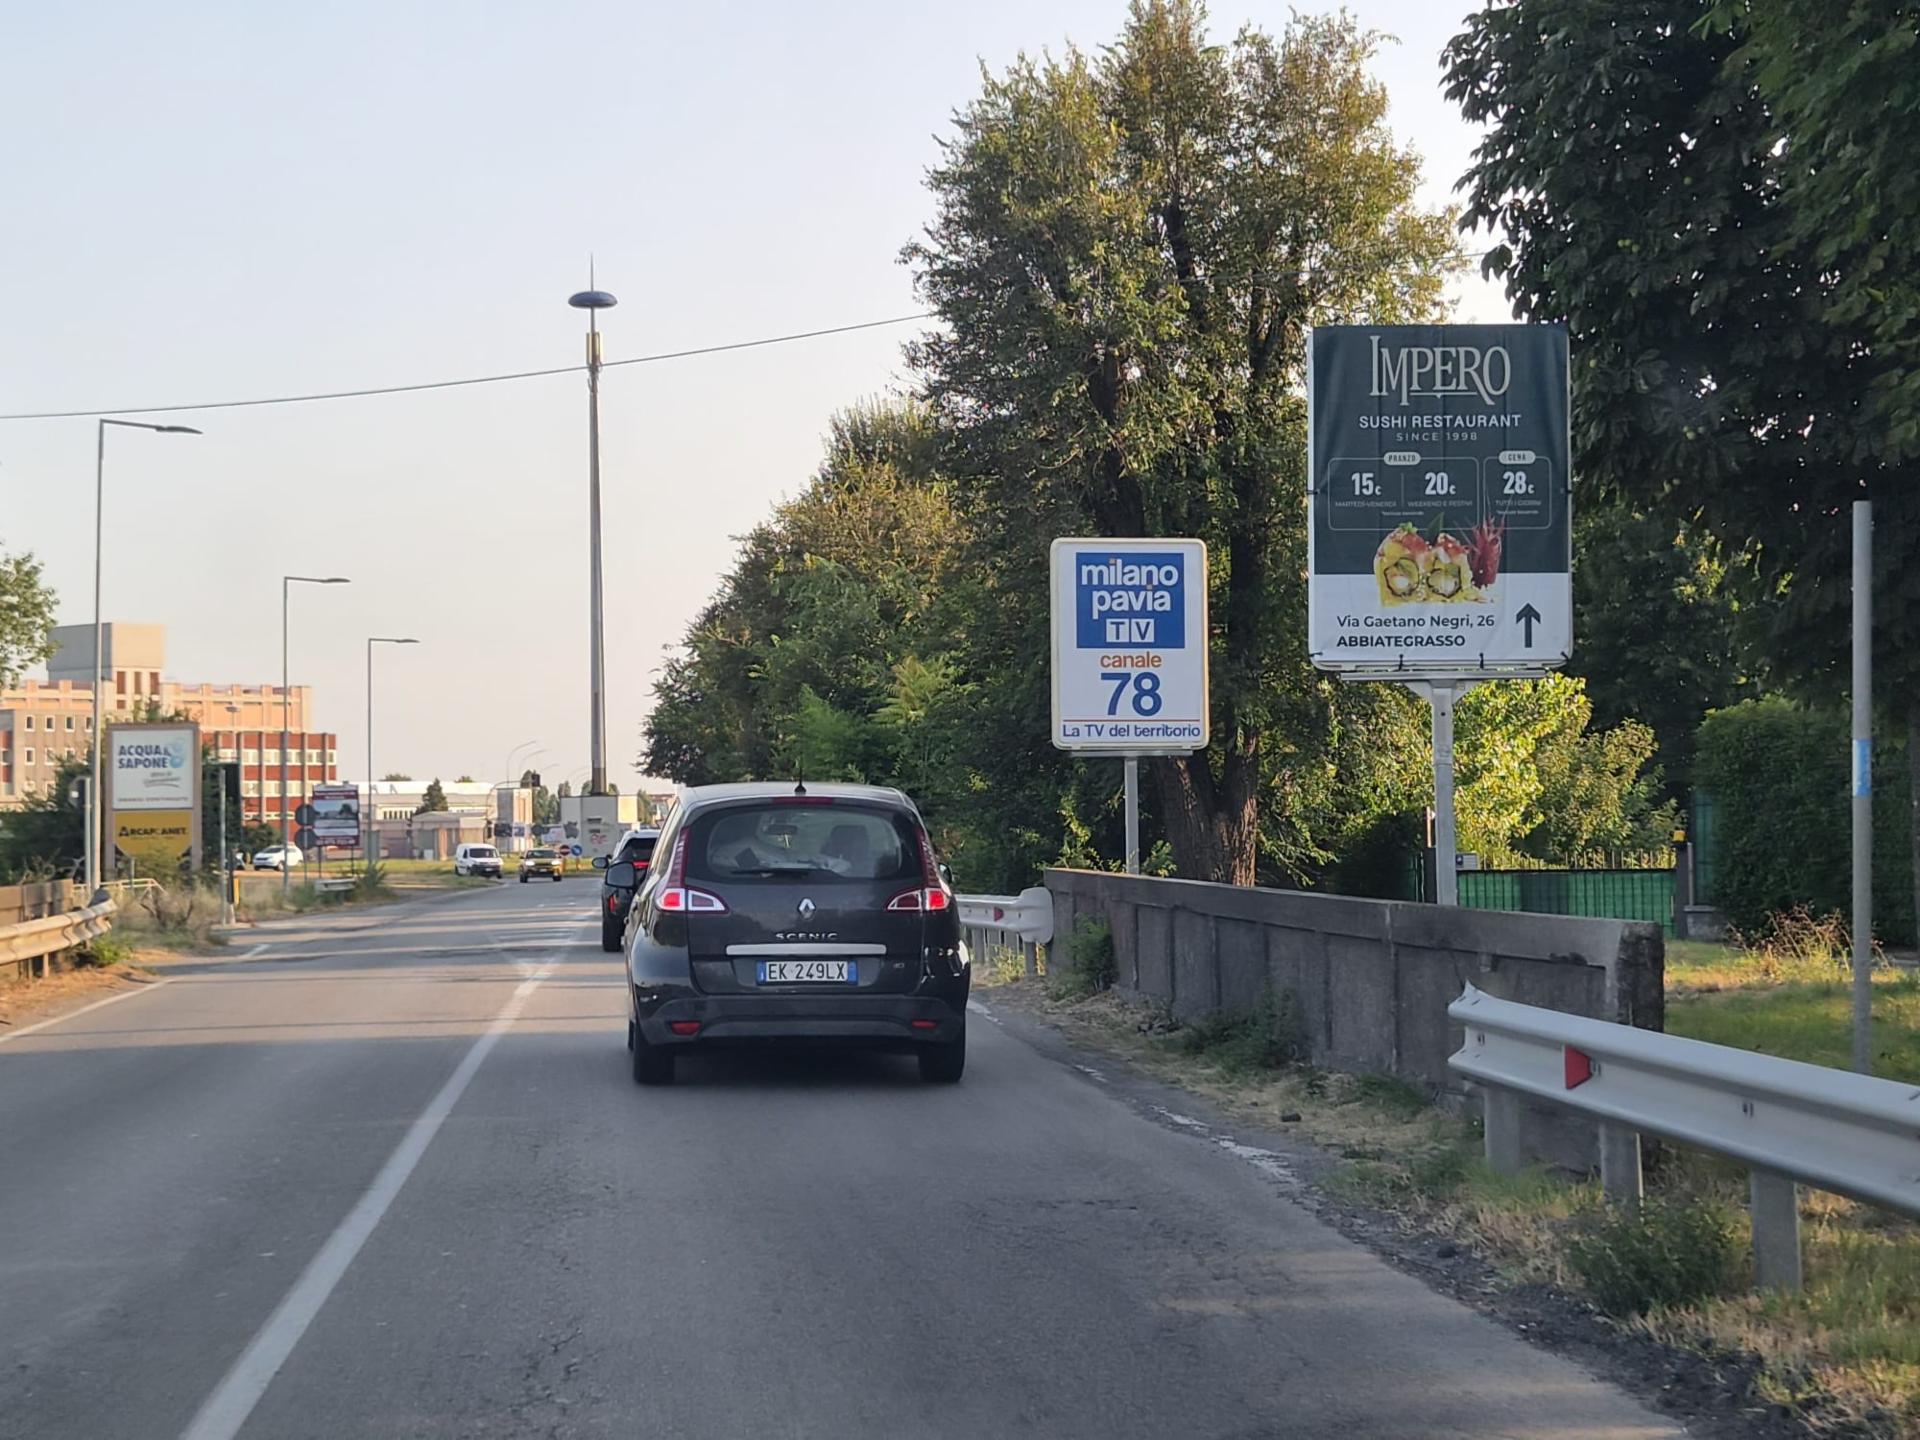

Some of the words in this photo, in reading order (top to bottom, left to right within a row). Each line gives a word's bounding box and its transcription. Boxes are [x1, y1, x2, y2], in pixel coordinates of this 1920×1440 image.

[1369, 335, 1511, 406] IMPERO
[1359, 415, 1407, 429] SUSHI
[1412, 414, 1522, 429] RESTAURANT
[1396, 432, 1439, 442] SINCE
[1446, 431, 1477, 441] 1998
[1388, 454, 1417, 463] PRANZO
[1507, 453, 1527, 462] CENA
[1081, 558, 1179, 587] milano
[1092, 584, 1171, 620] pavia
[1336, 615, 1360, 628] Via
[1363, 615, 1427, 628] Gaetano
[1430, 614, 1473, 629] Negri,
[1477, 614, 1495, 627] 26
[1109, 621, 1150, 641] TV
[1336, 635, 1466, 648] ABBIATEGRASSO
[1100, 651, 1163, 669] canale
[1100, 671, 1163, 717] 78
[1062, 724, 1080, 737] La
[1084, 724, 1104, 737] TV
[1109, 724, 1130, 737] del
[1134, 724, 1201, 737] territorio
[118, 744, 162, 757] ACQUA
[118, 757, 169, 769] SAPONE
[775, 932, 838, 941] SCENIC
[768, 963, 788, 980] EK
[795, 962, 846, 980] 249LX
